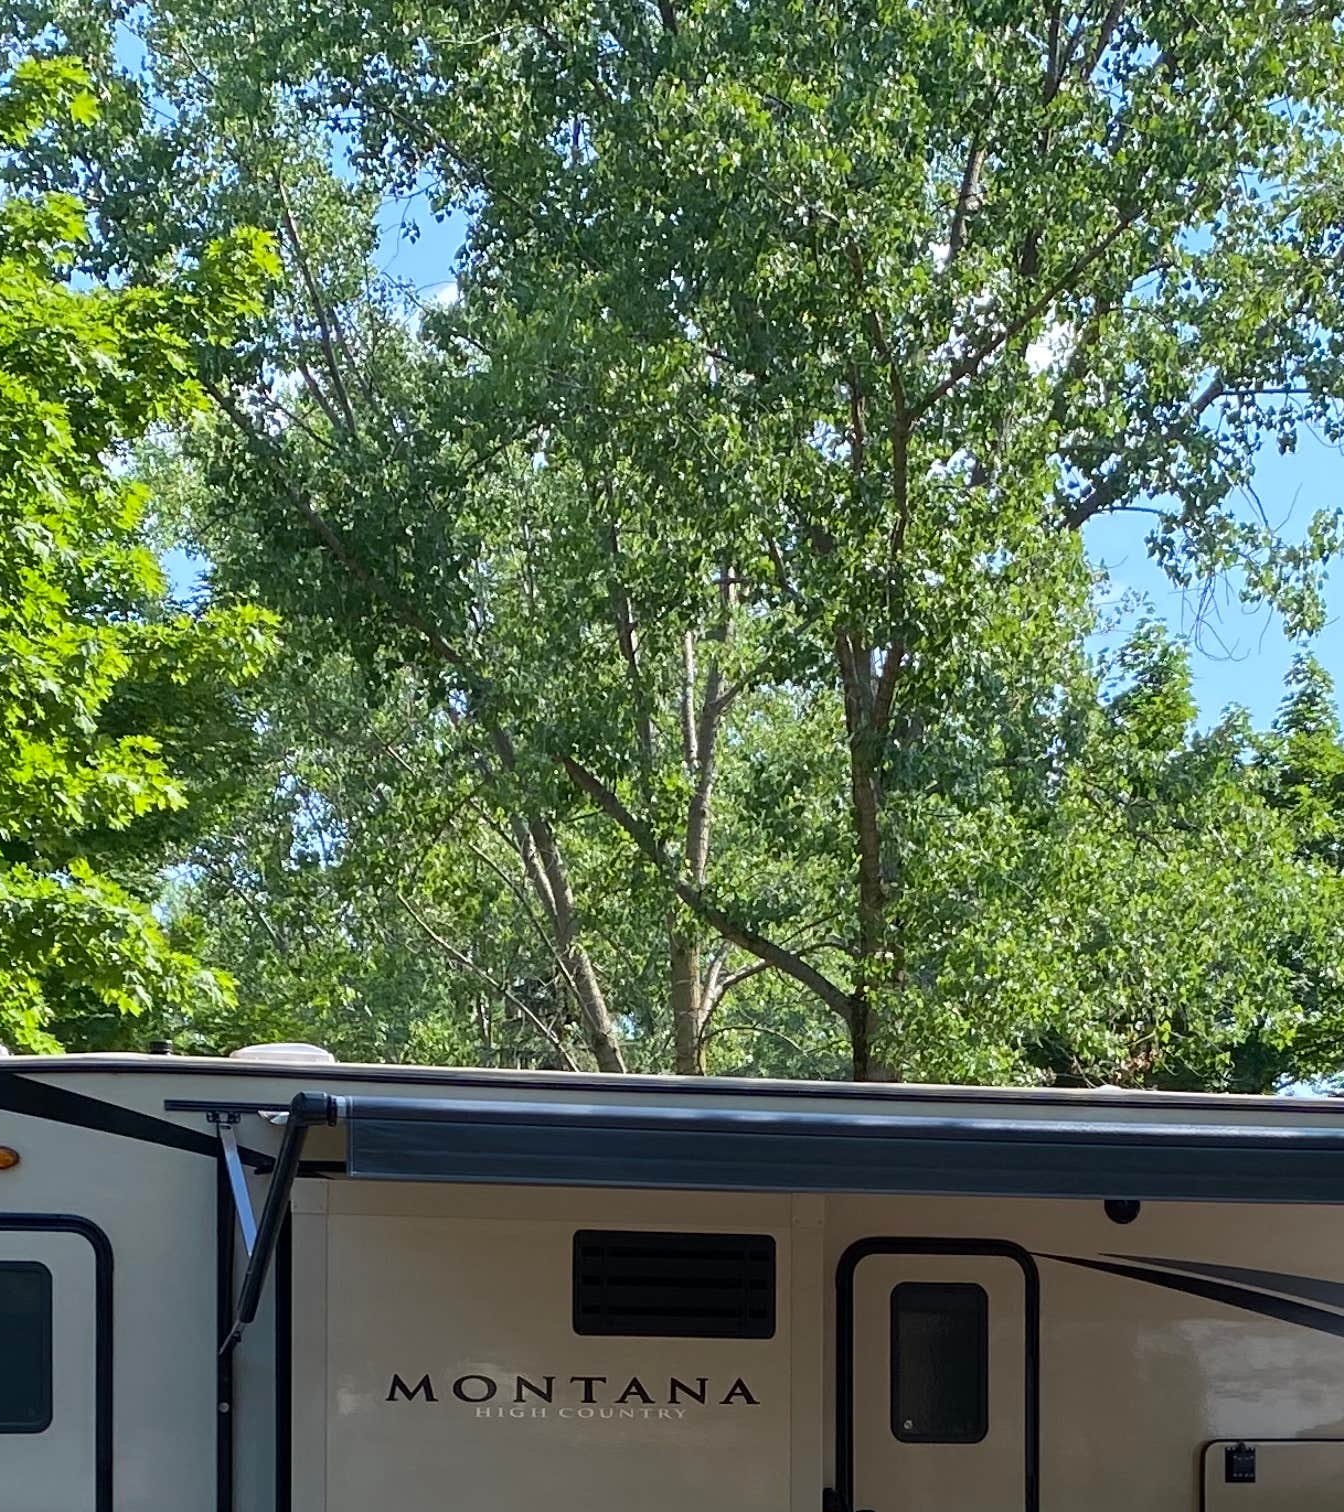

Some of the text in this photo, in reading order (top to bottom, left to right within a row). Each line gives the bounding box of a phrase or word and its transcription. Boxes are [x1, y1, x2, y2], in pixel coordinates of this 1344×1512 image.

[385, 1373, 761, 1405] MONTANA
[474, 1406, 689, 1420] HIGH COUNTRY
